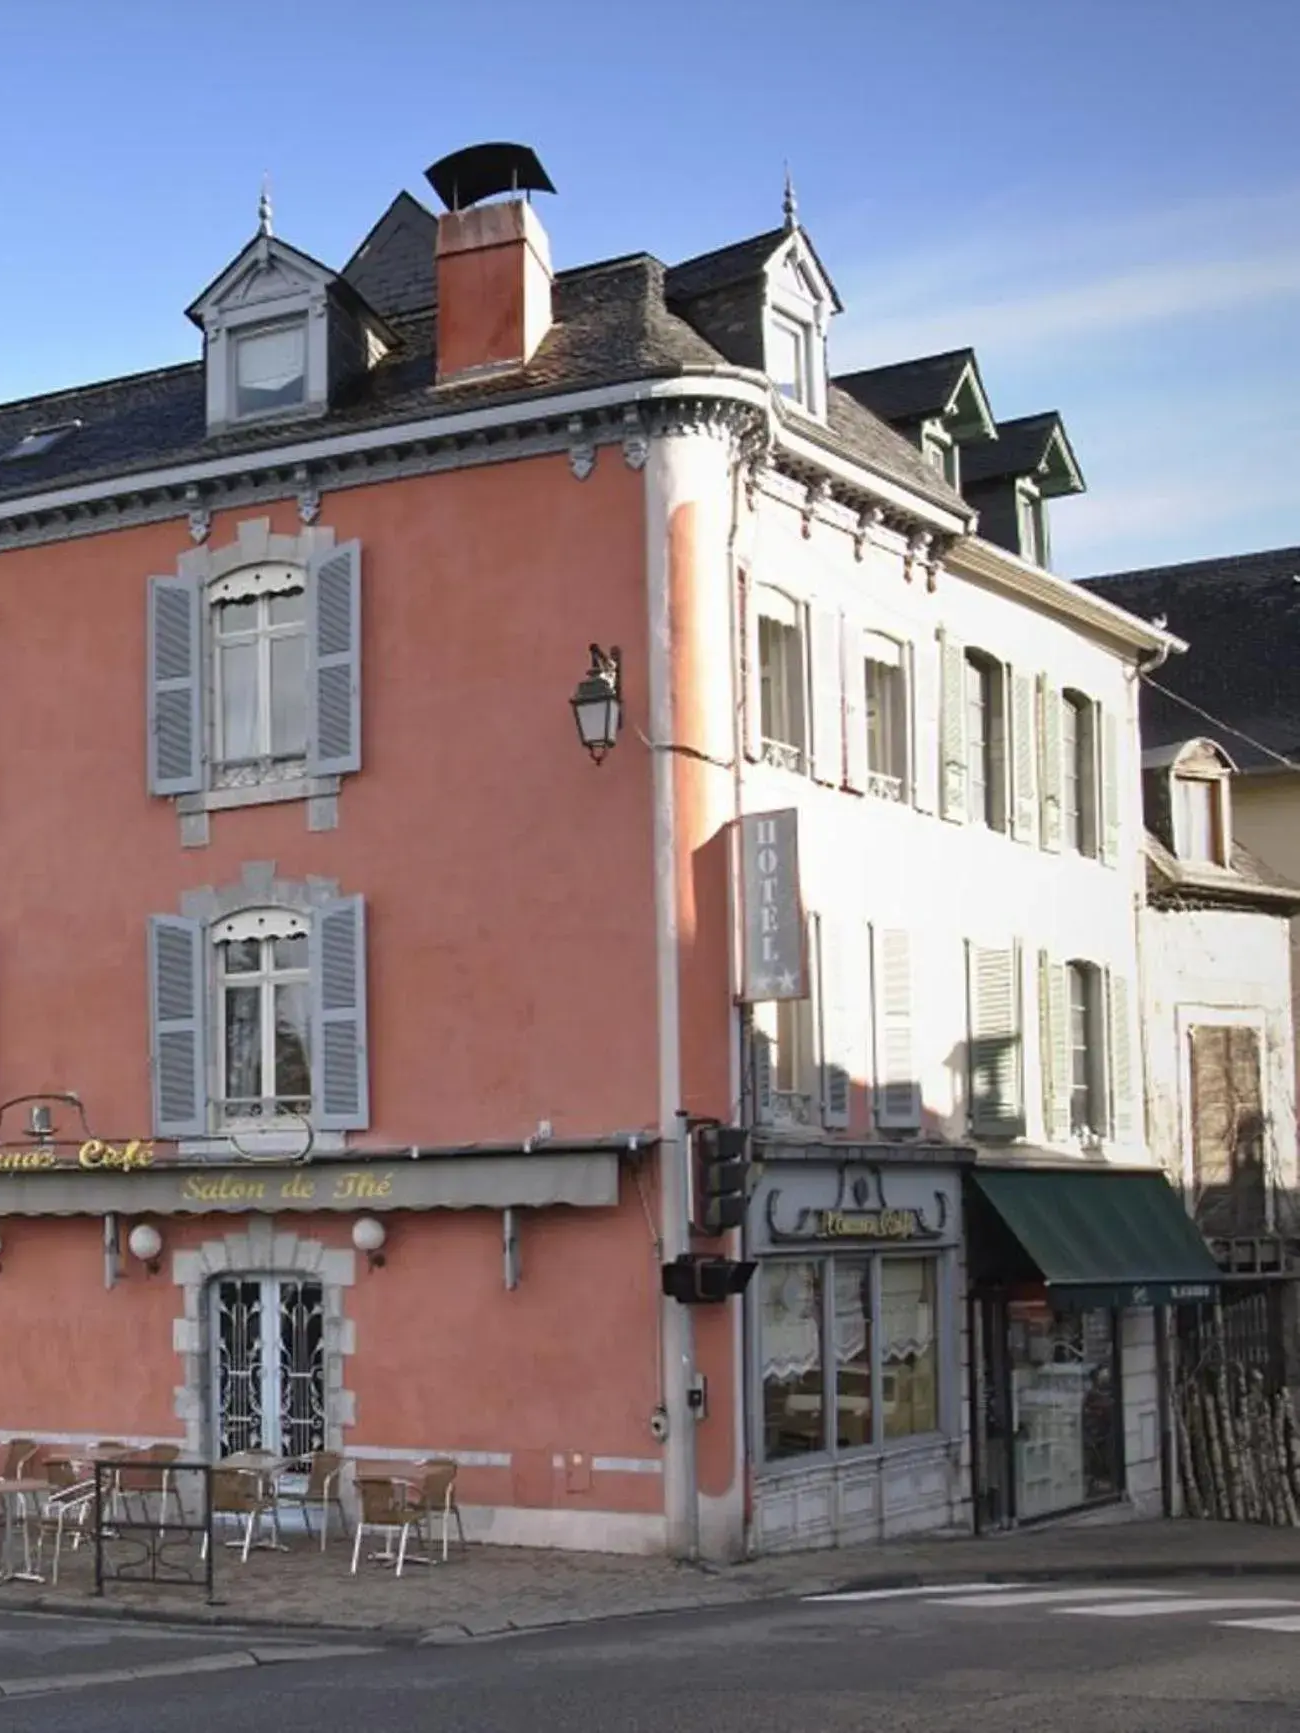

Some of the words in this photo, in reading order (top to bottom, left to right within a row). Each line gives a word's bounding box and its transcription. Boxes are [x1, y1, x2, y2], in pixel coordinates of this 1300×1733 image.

[756, 820, 780, 961] HOTEL
[79, 1138, 155, 1173] Café
[181, 1172, 264, 1200] Salon
[279, 1172, 315, 1198] de
[332, 1168, 394, 1198] Thé
